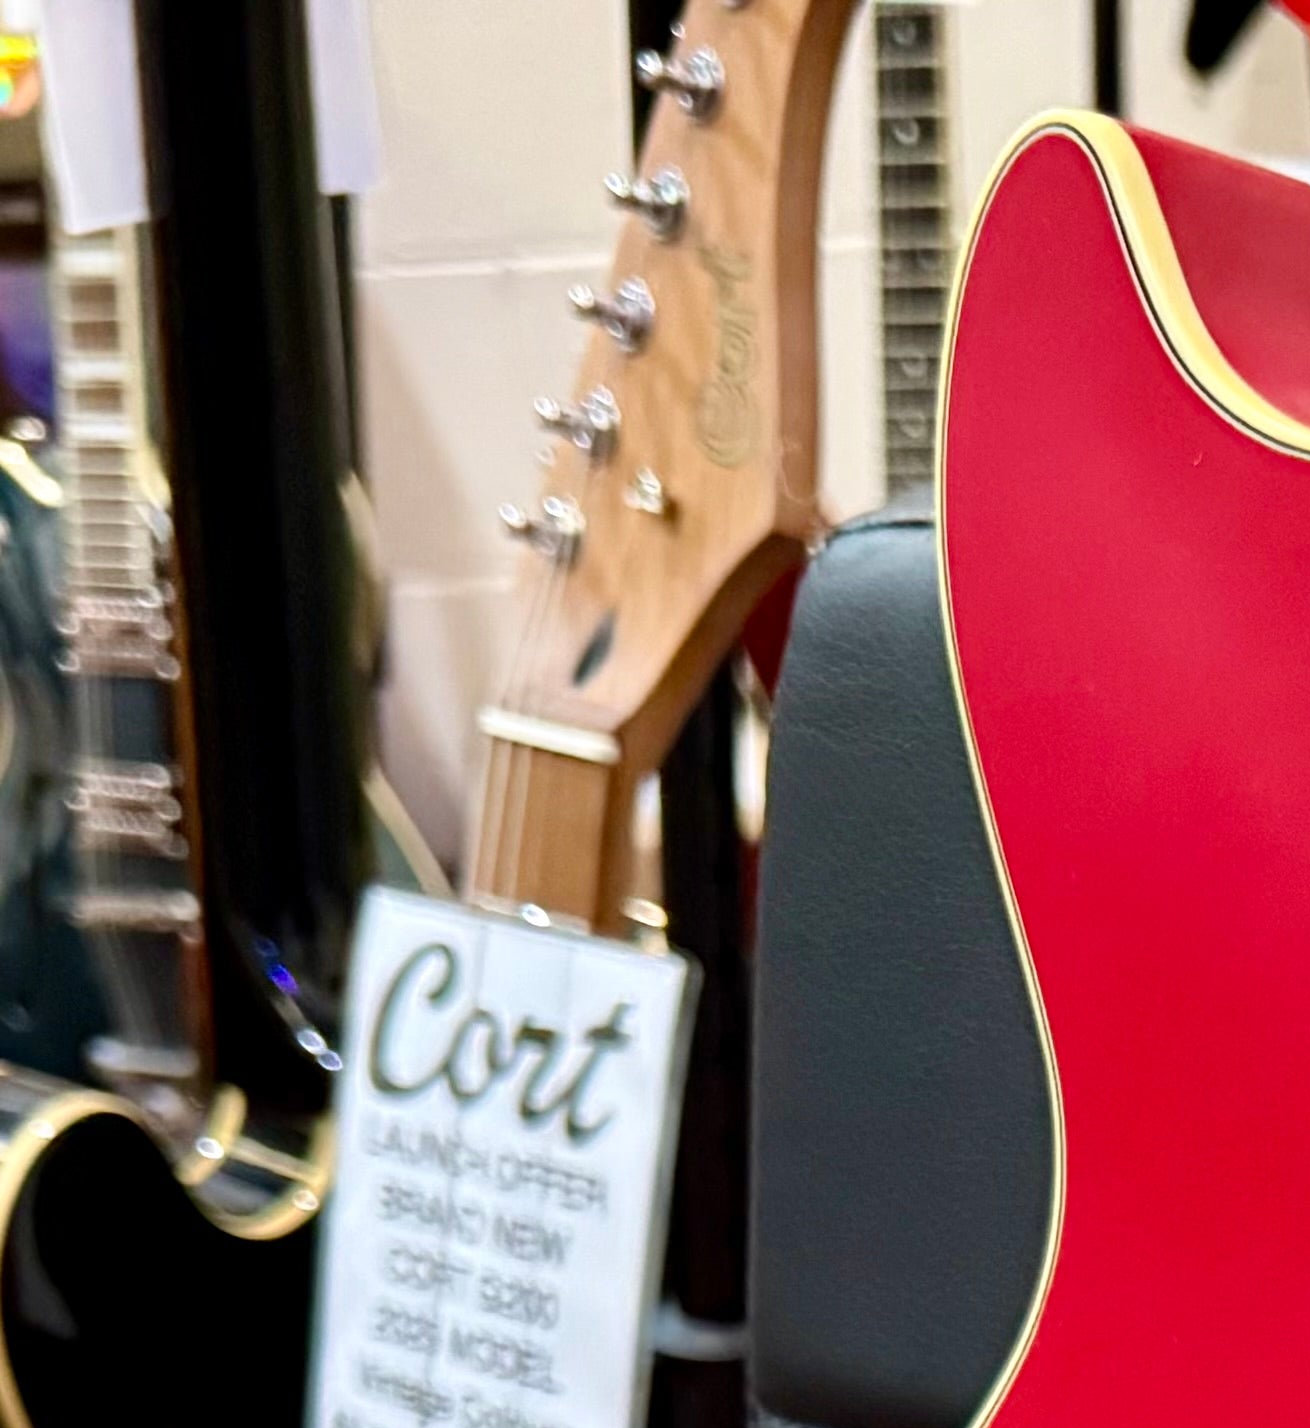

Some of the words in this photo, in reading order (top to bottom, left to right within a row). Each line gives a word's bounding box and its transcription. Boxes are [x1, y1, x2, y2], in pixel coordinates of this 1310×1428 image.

[368, 942, 637, 1142] Cort
[365, 1115, 492, 1185] LAUNCH
[492, 1150, 612, 1218] OFFER
[380, 1181, 489, 1247] BRAND
[488, 1213, 571, 1272] NEW
[445, 1324, 562, 1395] MODEL
